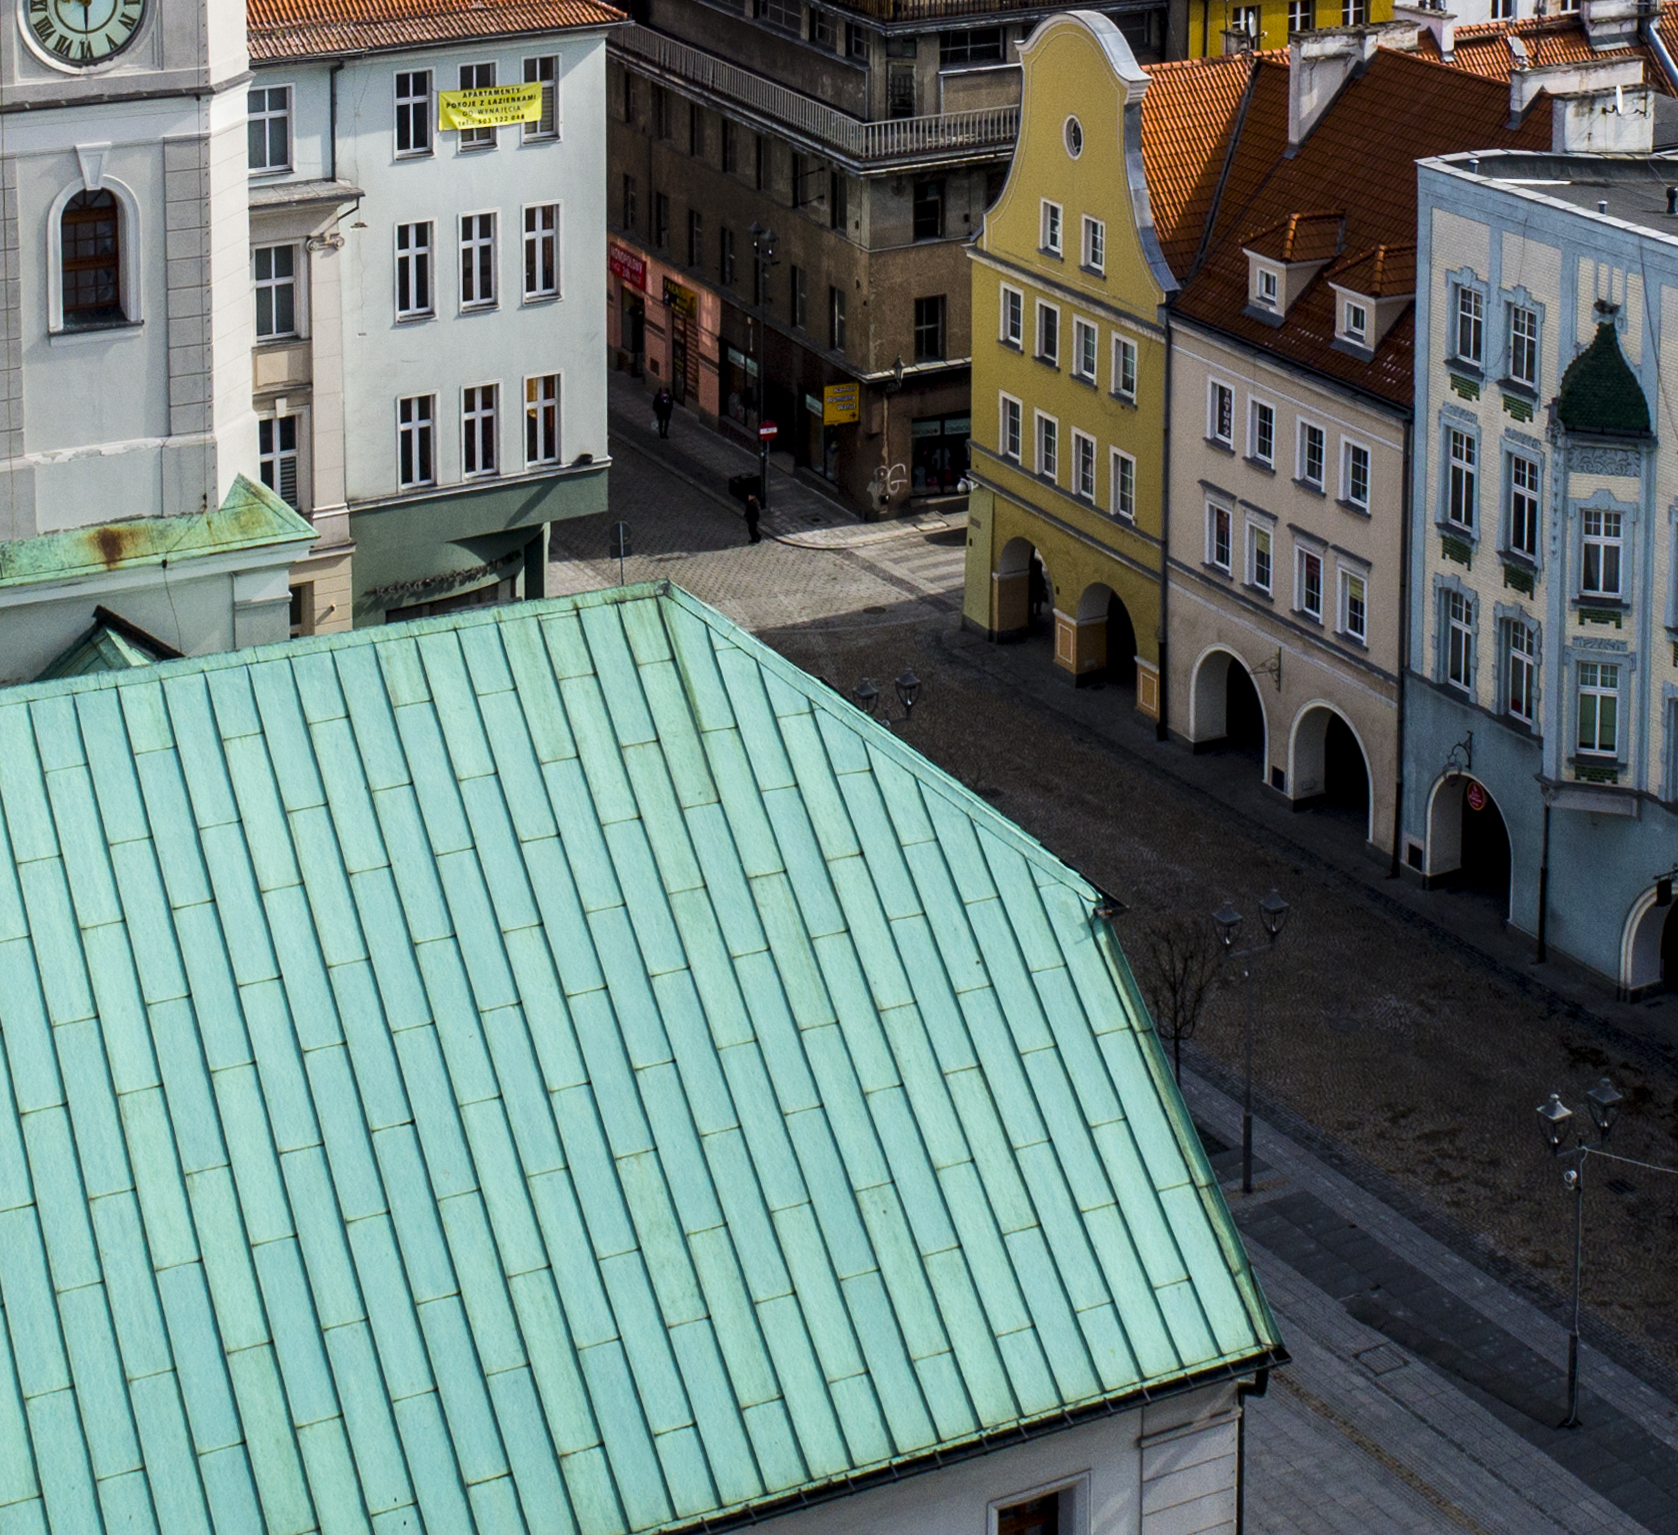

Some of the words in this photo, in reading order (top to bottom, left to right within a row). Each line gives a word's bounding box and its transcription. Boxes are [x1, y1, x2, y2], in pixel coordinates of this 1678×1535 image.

[33, 15, 57, 43] VIII
[118, 13, 137, 32] IV
[53, 34, 73, 59] VII
[105, 33, 119, 52] V
[463, 87, 521, 99] APARTAMENTY
